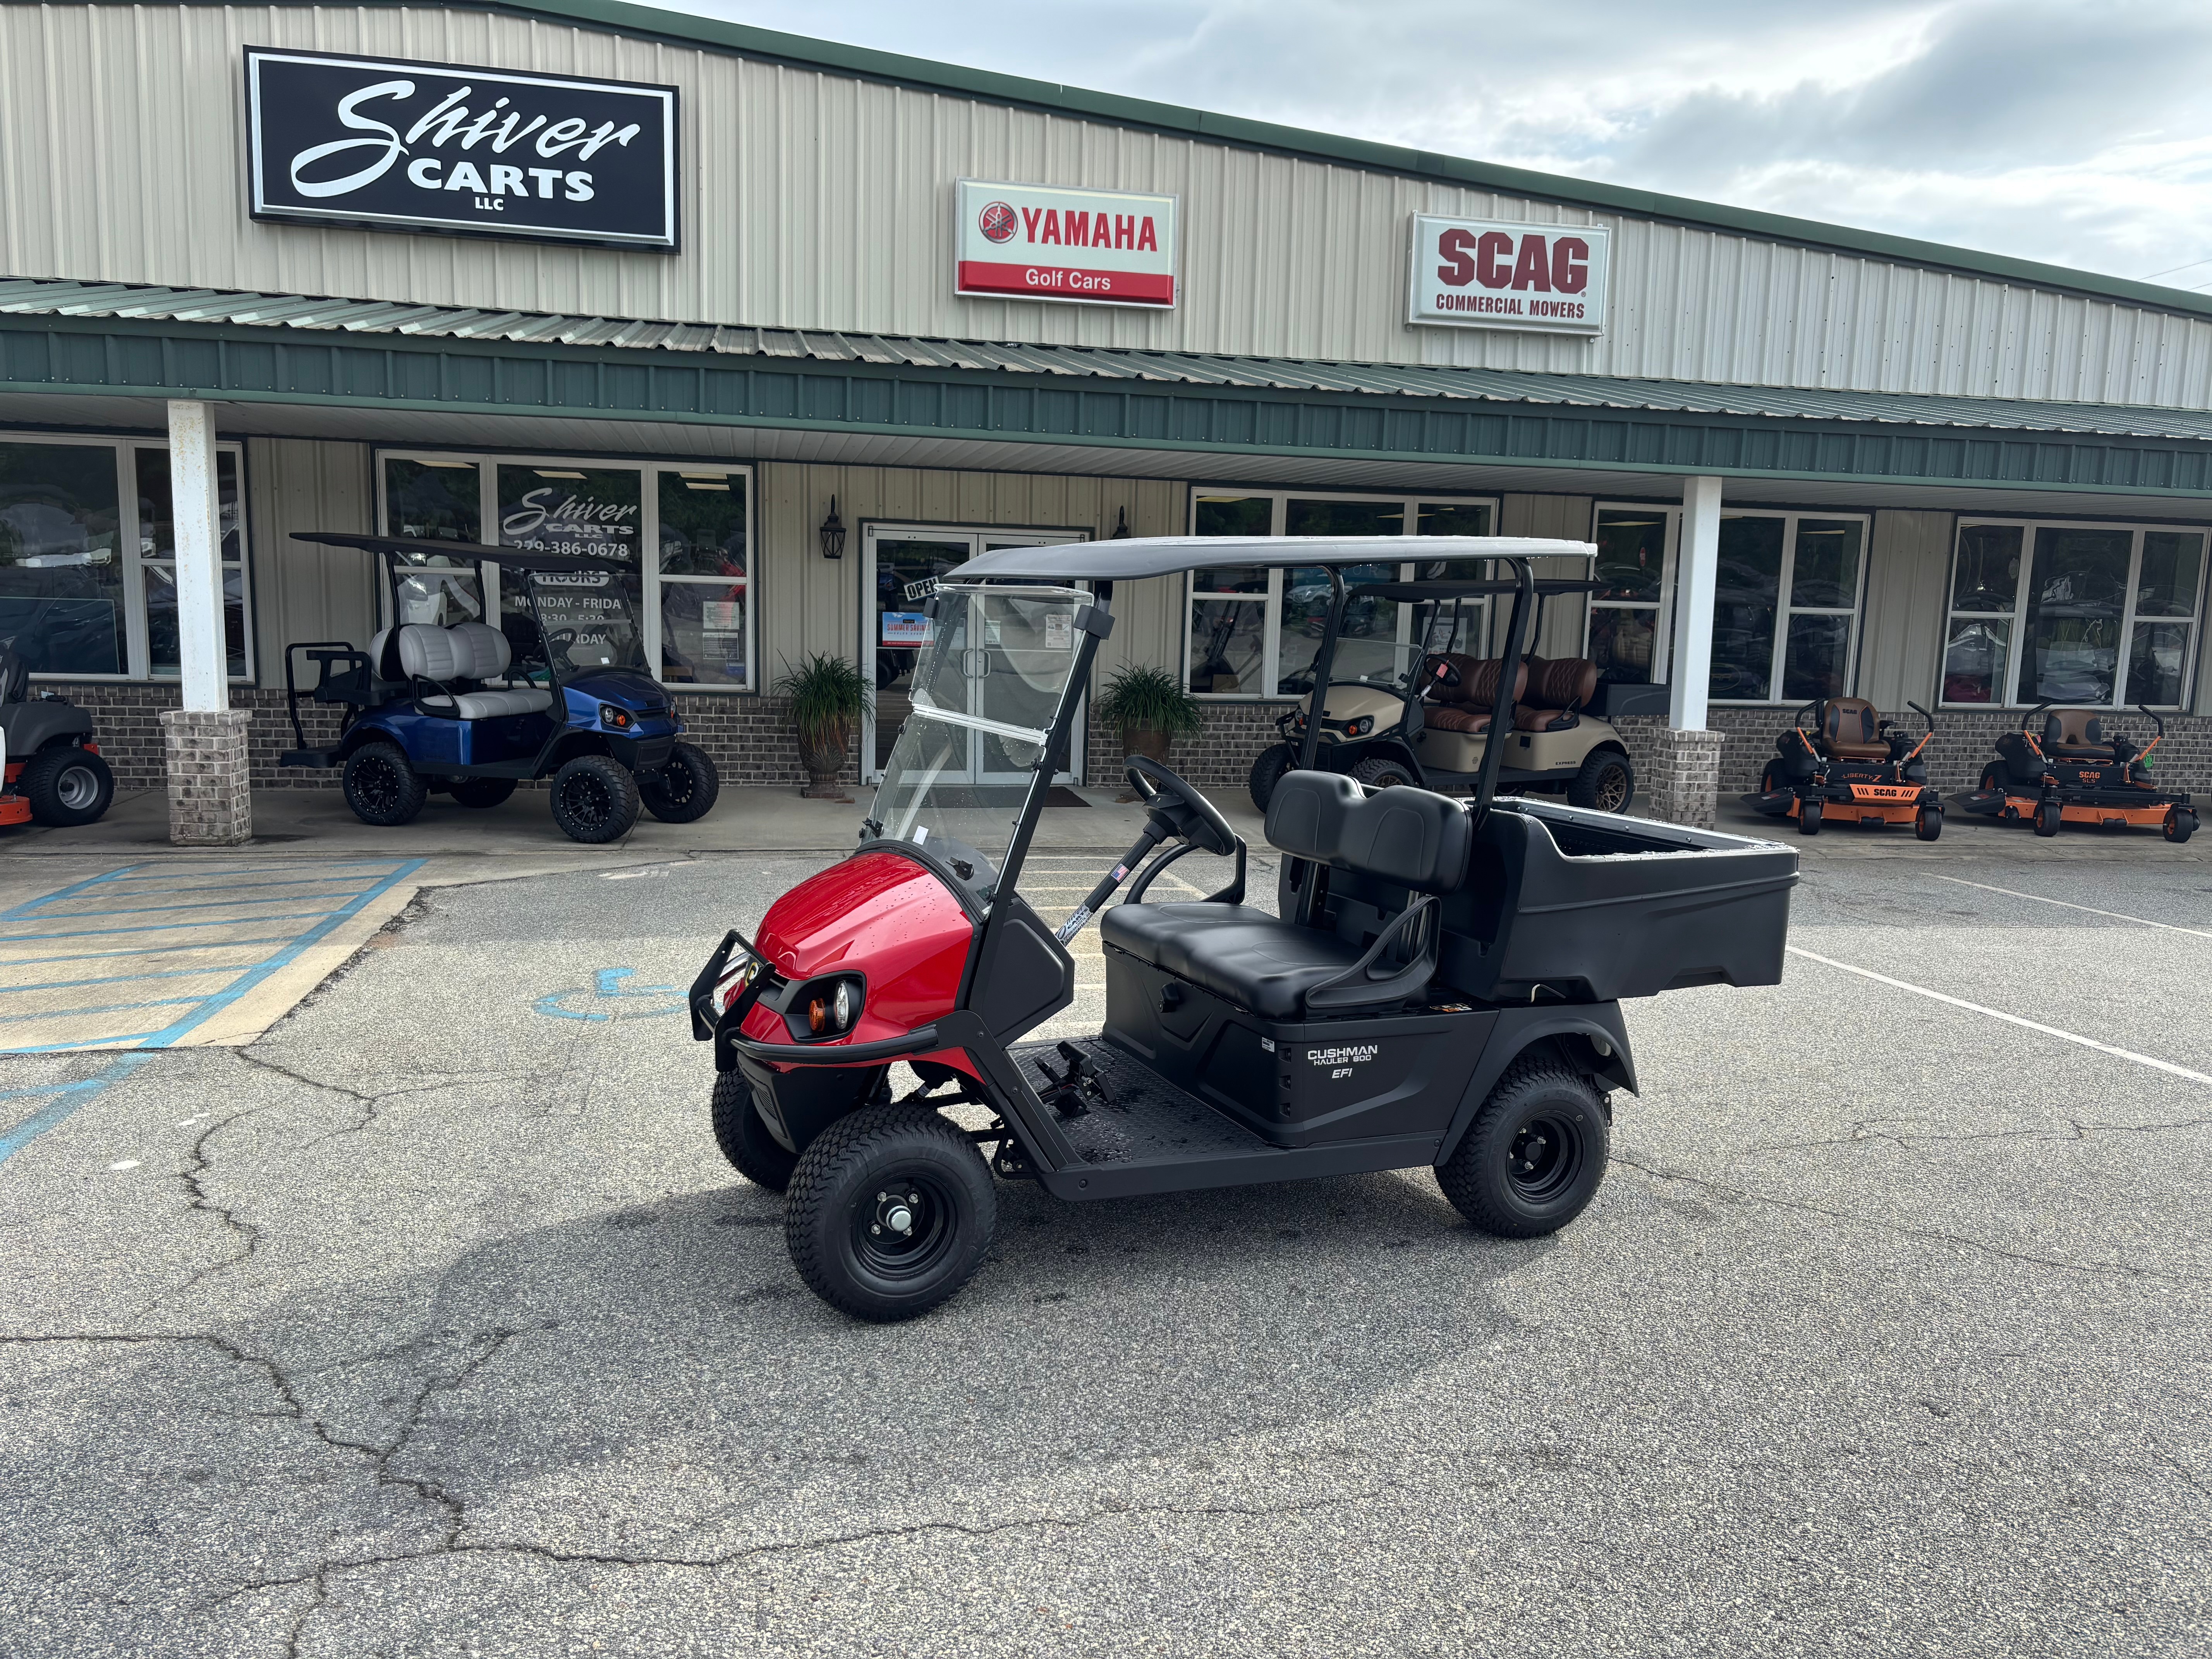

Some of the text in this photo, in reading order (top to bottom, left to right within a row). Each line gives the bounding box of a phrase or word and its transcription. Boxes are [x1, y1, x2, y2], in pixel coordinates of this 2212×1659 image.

[291, 80, 641, 198] Shiver
[407, 158, 595, 202] CARTS
[475, 196, 504, 211] LLC
[1022, 207, 1158, 252] YAMAHA
[1437, 228, 1589, 294] SCAG
[1025, 268, 1111, 290] Golf Cars
[1436, 294, 1585, 319] COMMERCIAL MOWERS
[503, 488, 637, 535] Shiver
[545, 523, 634, 534] CARTS
[907, 578, 938, 599] OPEN
[583, 598, 622, 609] FRIDA
[1874, 788, 1897, 797] SCAG
[1307, 1044, 1378, 1060] CUSHMAN
[1314, 1057, 1348, 1066] HAULER
[1331, 1068, 1353, 1079] EFI
